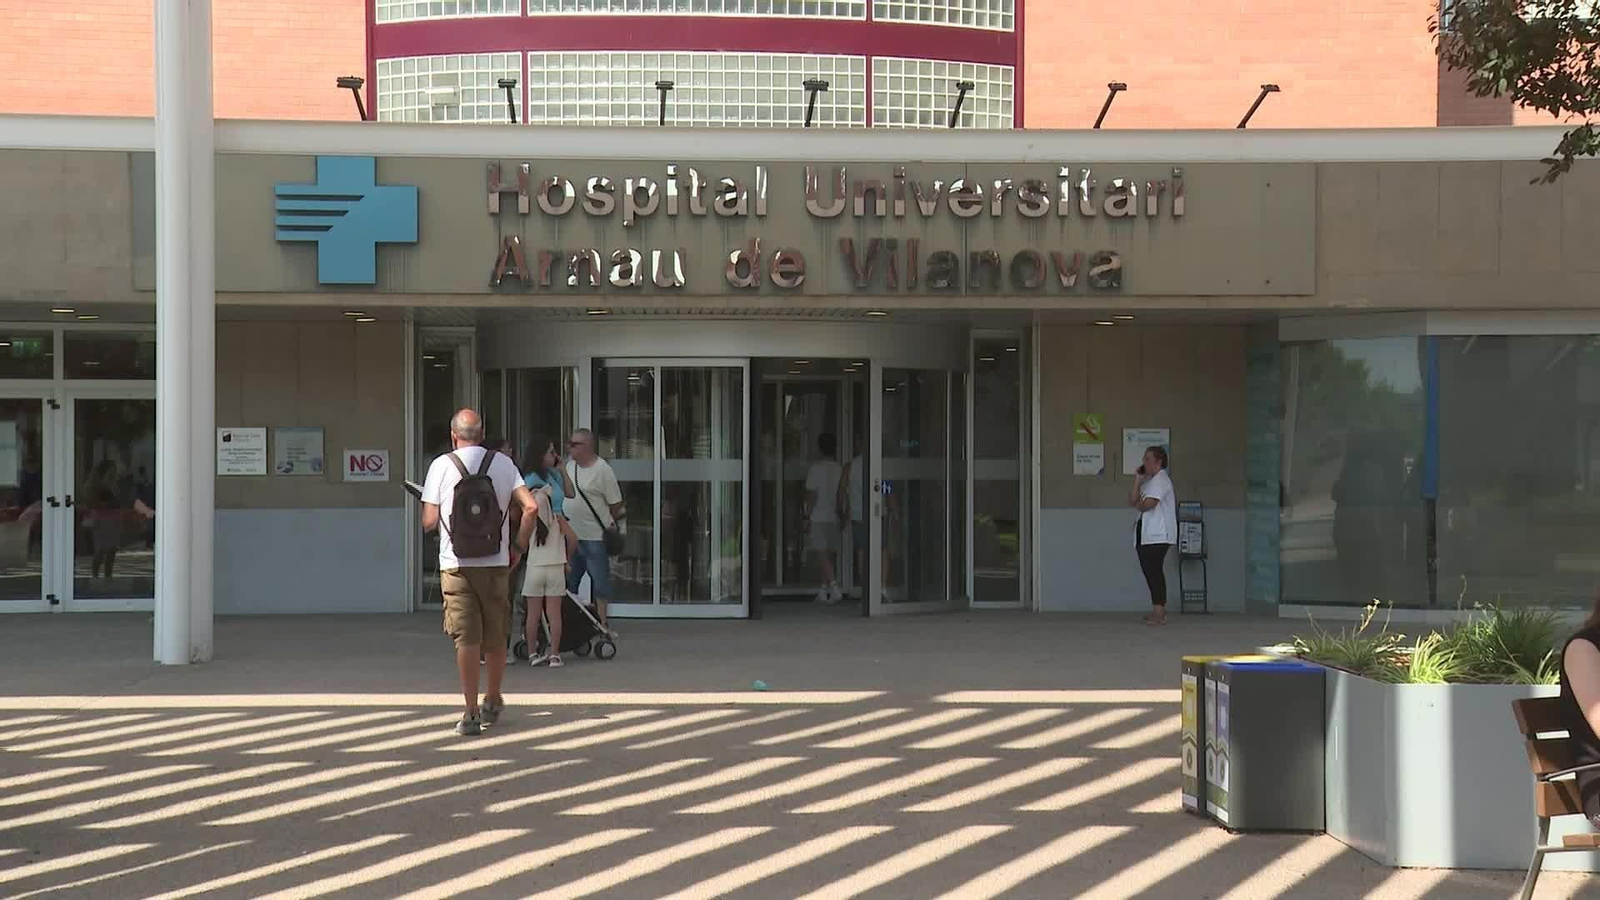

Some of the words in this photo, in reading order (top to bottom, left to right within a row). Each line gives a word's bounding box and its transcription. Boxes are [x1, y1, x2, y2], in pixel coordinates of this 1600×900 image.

[487, 162, 767, 227] Hospital
[805, 166, 1186, 218] Universitari
[489, 235, 687, 288] Arnau
[725, 237, 806, 288] de
[840, 237, 1123, 289] Vilanova
[350, 454, 383, 472] NO
